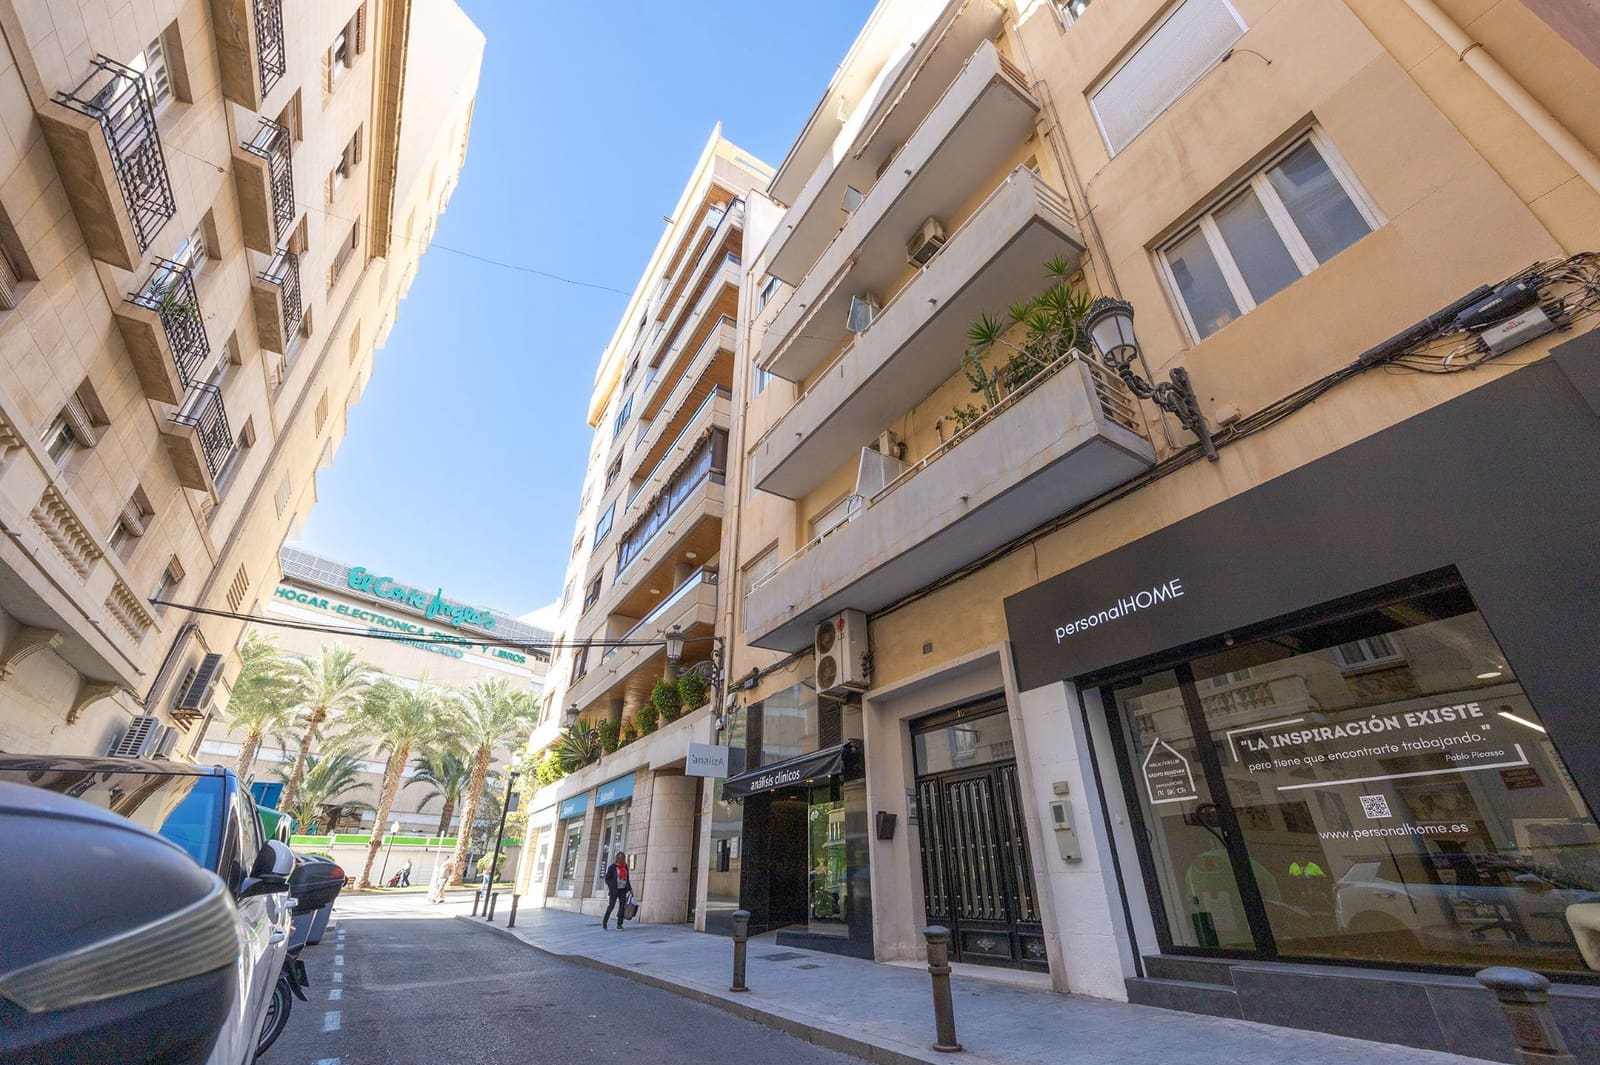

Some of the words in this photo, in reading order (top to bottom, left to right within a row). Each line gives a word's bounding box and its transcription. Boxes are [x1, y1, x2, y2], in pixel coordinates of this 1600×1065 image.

[348, 566, 373, 592] El
[374, 576, 427, 609] Corte
[273, 586, 329, 610] HOGAR
[492, 648, 526, 664] LIBROS
[1055, 578, 1184, 644] personalHOME
[1270, 715, 1400, 748] INSPIRACIÓN
[1404, 702, 1484, 728] EXISTE
[1248, 761, 1272, 773] pero
[1274, 758, 1301, 769] tiene
[1304, 754, 1325, 766] que
[1327, 744, 1399, 761] encontrarte
[1445, 751, 1470, 762] Pablo
[1471, 750, 1505, 759] Picasso
[1319, 823, 1469, 841] www.personalhome.es
